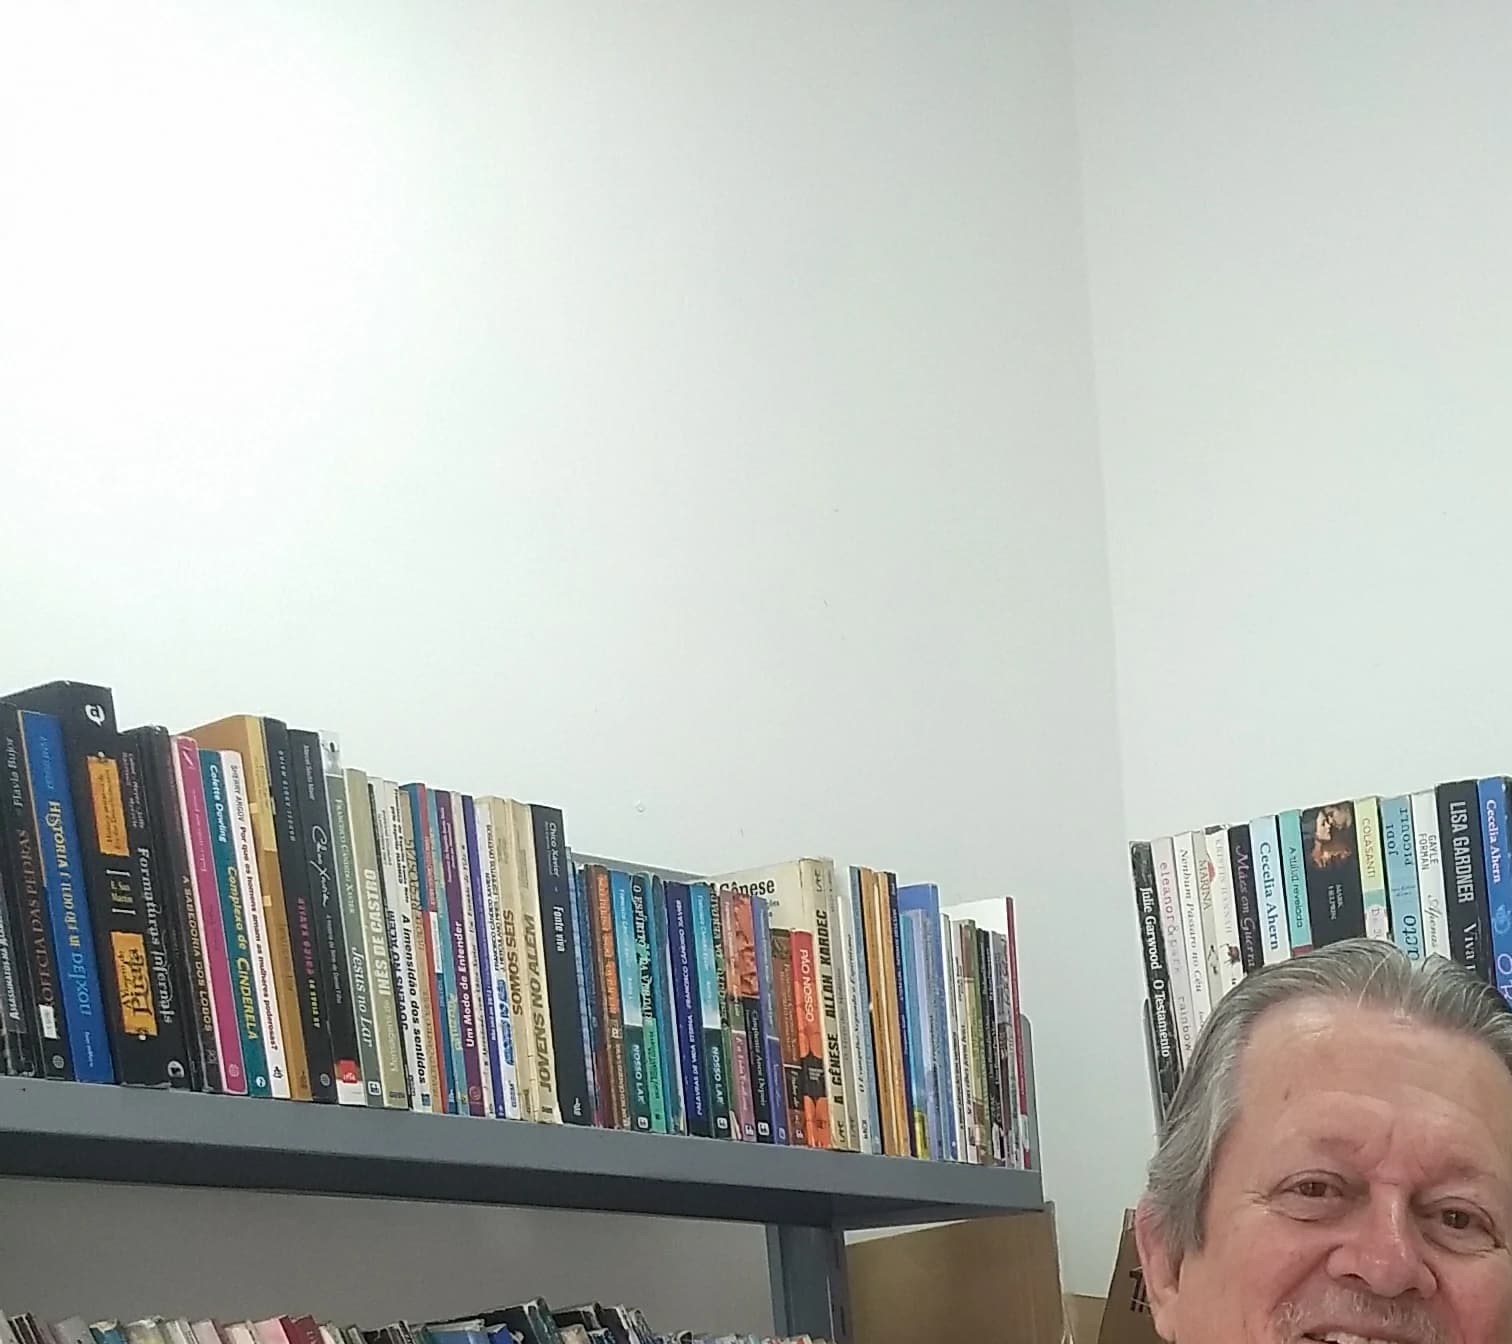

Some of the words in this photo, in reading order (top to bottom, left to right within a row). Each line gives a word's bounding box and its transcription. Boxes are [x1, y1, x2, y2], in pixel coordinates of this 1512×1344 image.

[210, 764, 219, 802] Colette
[213, 804, 226, 843] Dowling
[1450, 801, 1463, 834] LISA
[1486, 800, 1498, 843] Cecelia
[1361, 818, 1375, 878] COLASANTI
[1428, 834, 1438, 864] GAYLE
[1453, 836, 1474, 903] GARDNER
[1491, 844, 1500, 883] Ahern
[227, 866, 244, 930] Complexo
[1139, 887, 1156, 913] Julie
[1259, 842, 1273, 899] Cecelia
[1266, 901, 1279, 950] Ahern
[138, 847, 162, 947] Formaturas
[150, 949, 173, 1024] Infernais
[236, 933, 246, 950] de
[502, 910, 516, 947] SEIS
[816, 910, 831, 966] KARDEC
[1143, 916, 1162, 971] Garwood
[236, 957, 258, 1040] CINDERELA
[509, 952, 524, 1016] SOMOS
[821, 975, 835, 1018] ALLAN
[1153, 980, 1164, 989] O
[1154, 992, 1169, 1058] Testamento
[826, 1033, 842, 1086] GÊNESE
[834, 1095, 844, 1105] A
